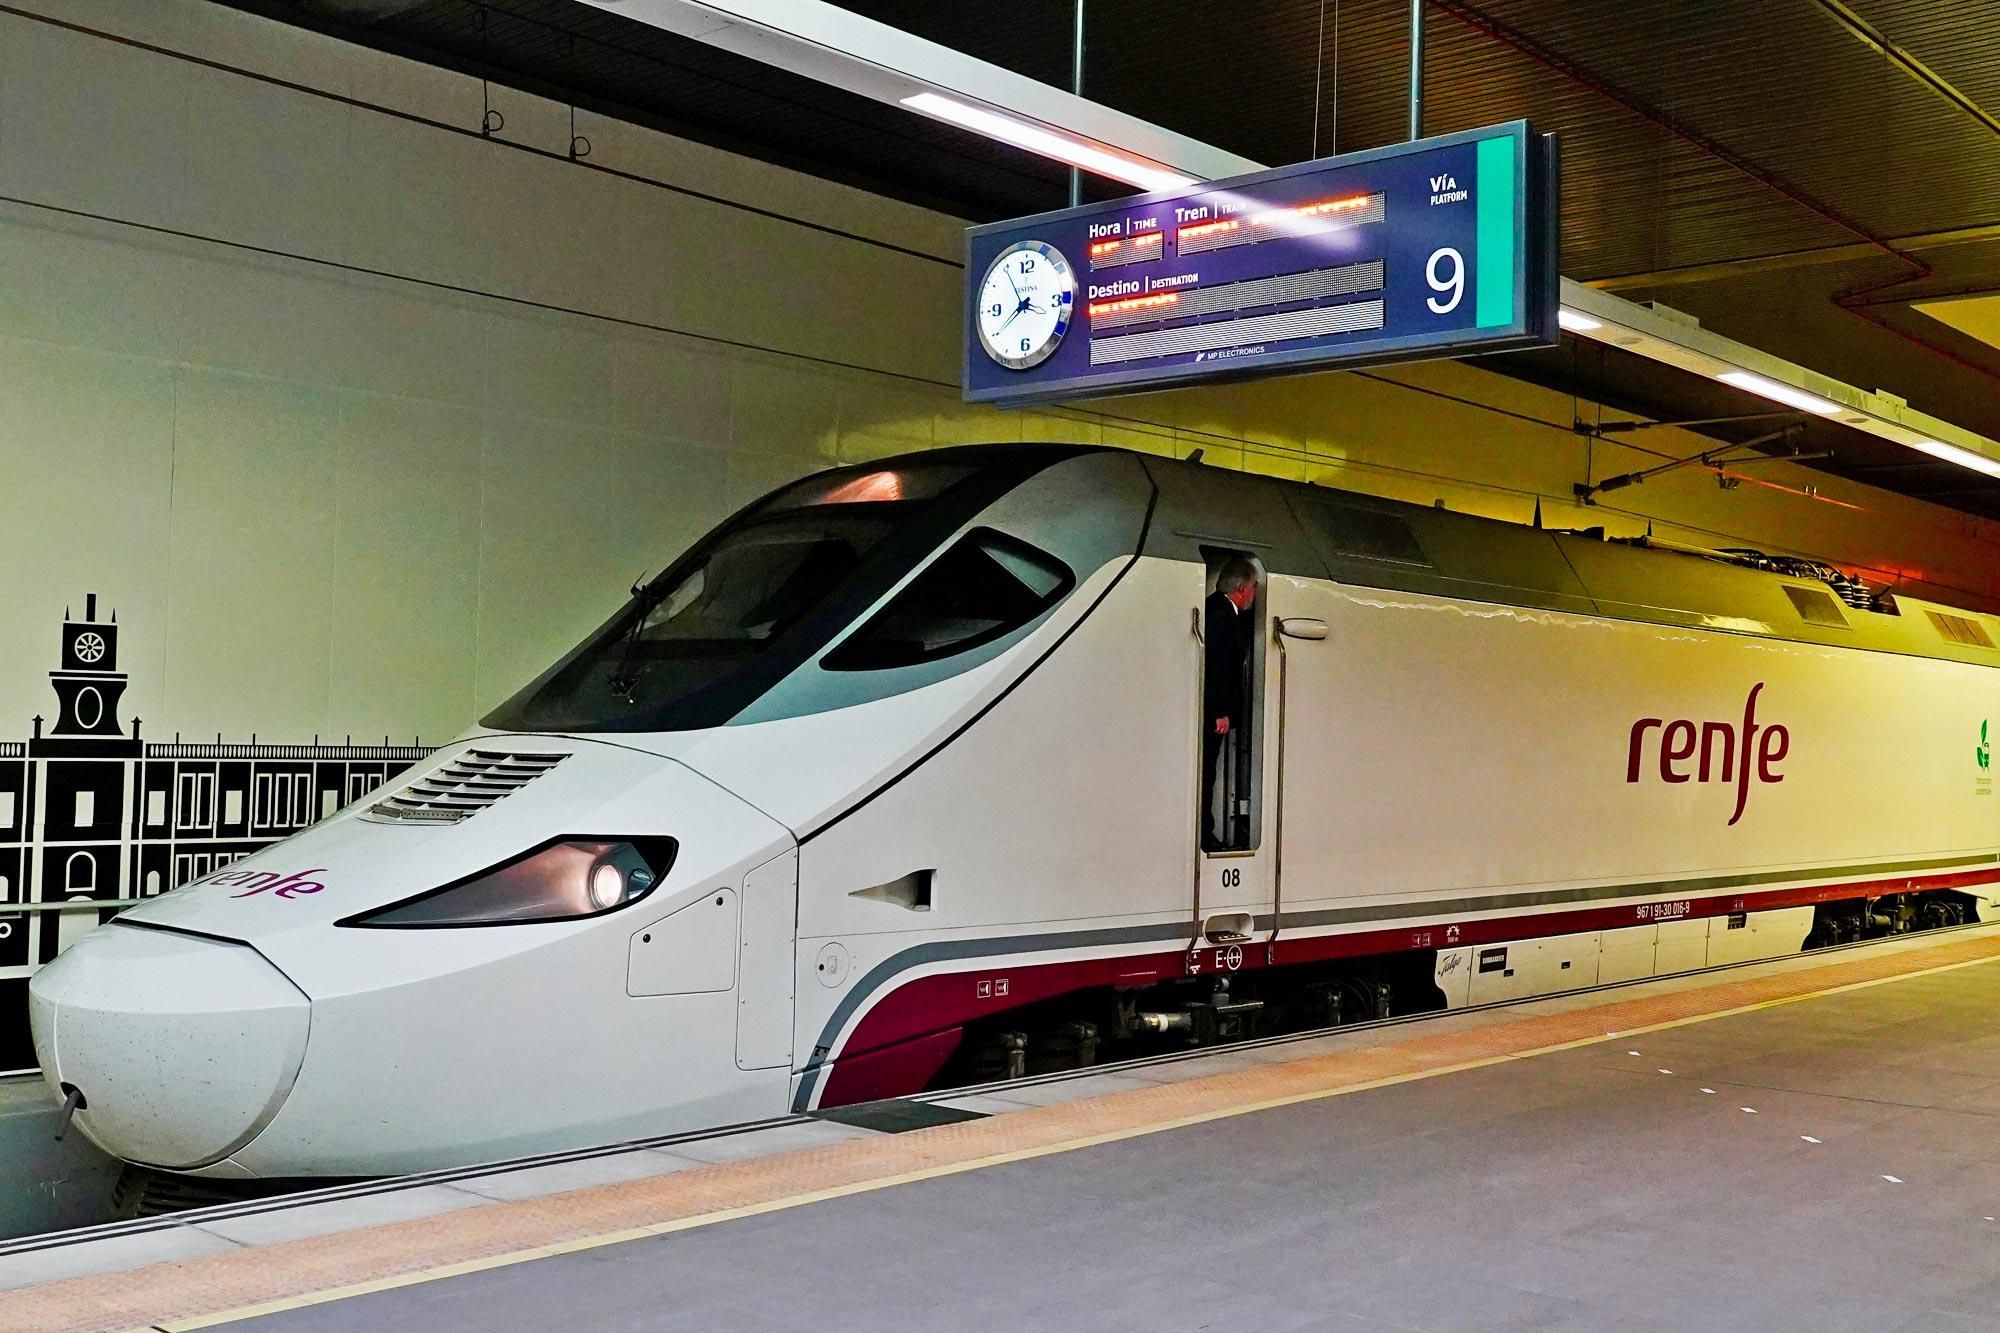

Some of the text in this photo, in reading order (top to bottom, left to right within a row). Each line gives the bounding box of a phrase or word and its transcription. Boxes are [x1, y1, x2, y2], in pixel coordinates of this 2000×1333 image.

[1430, 190, 1468, 206] PLATFORM
[1174, 206, 1208, 223] Tren
[1221, 202, 1246, 215] TRAIN
[1088, 217, 1158, 239] Hora TIME
[1019, 259, 1035, 274] 12
[1016, 285, 1038, 293] ESTINA
[1088, 272, 1199, 300] Destino DESTINATION
[1425, 247, 1465, 315] 9
[1051, 294, 1062, 308] 3
[991, 303, 1002, 317] 9
[1020, 338, 1031, 352] 6
[1207, 346, 1265, 360] MP ELECTRONICS
[1626, 682, 1790, 826] renfe
[1222, 868, 1240, 888] 08
